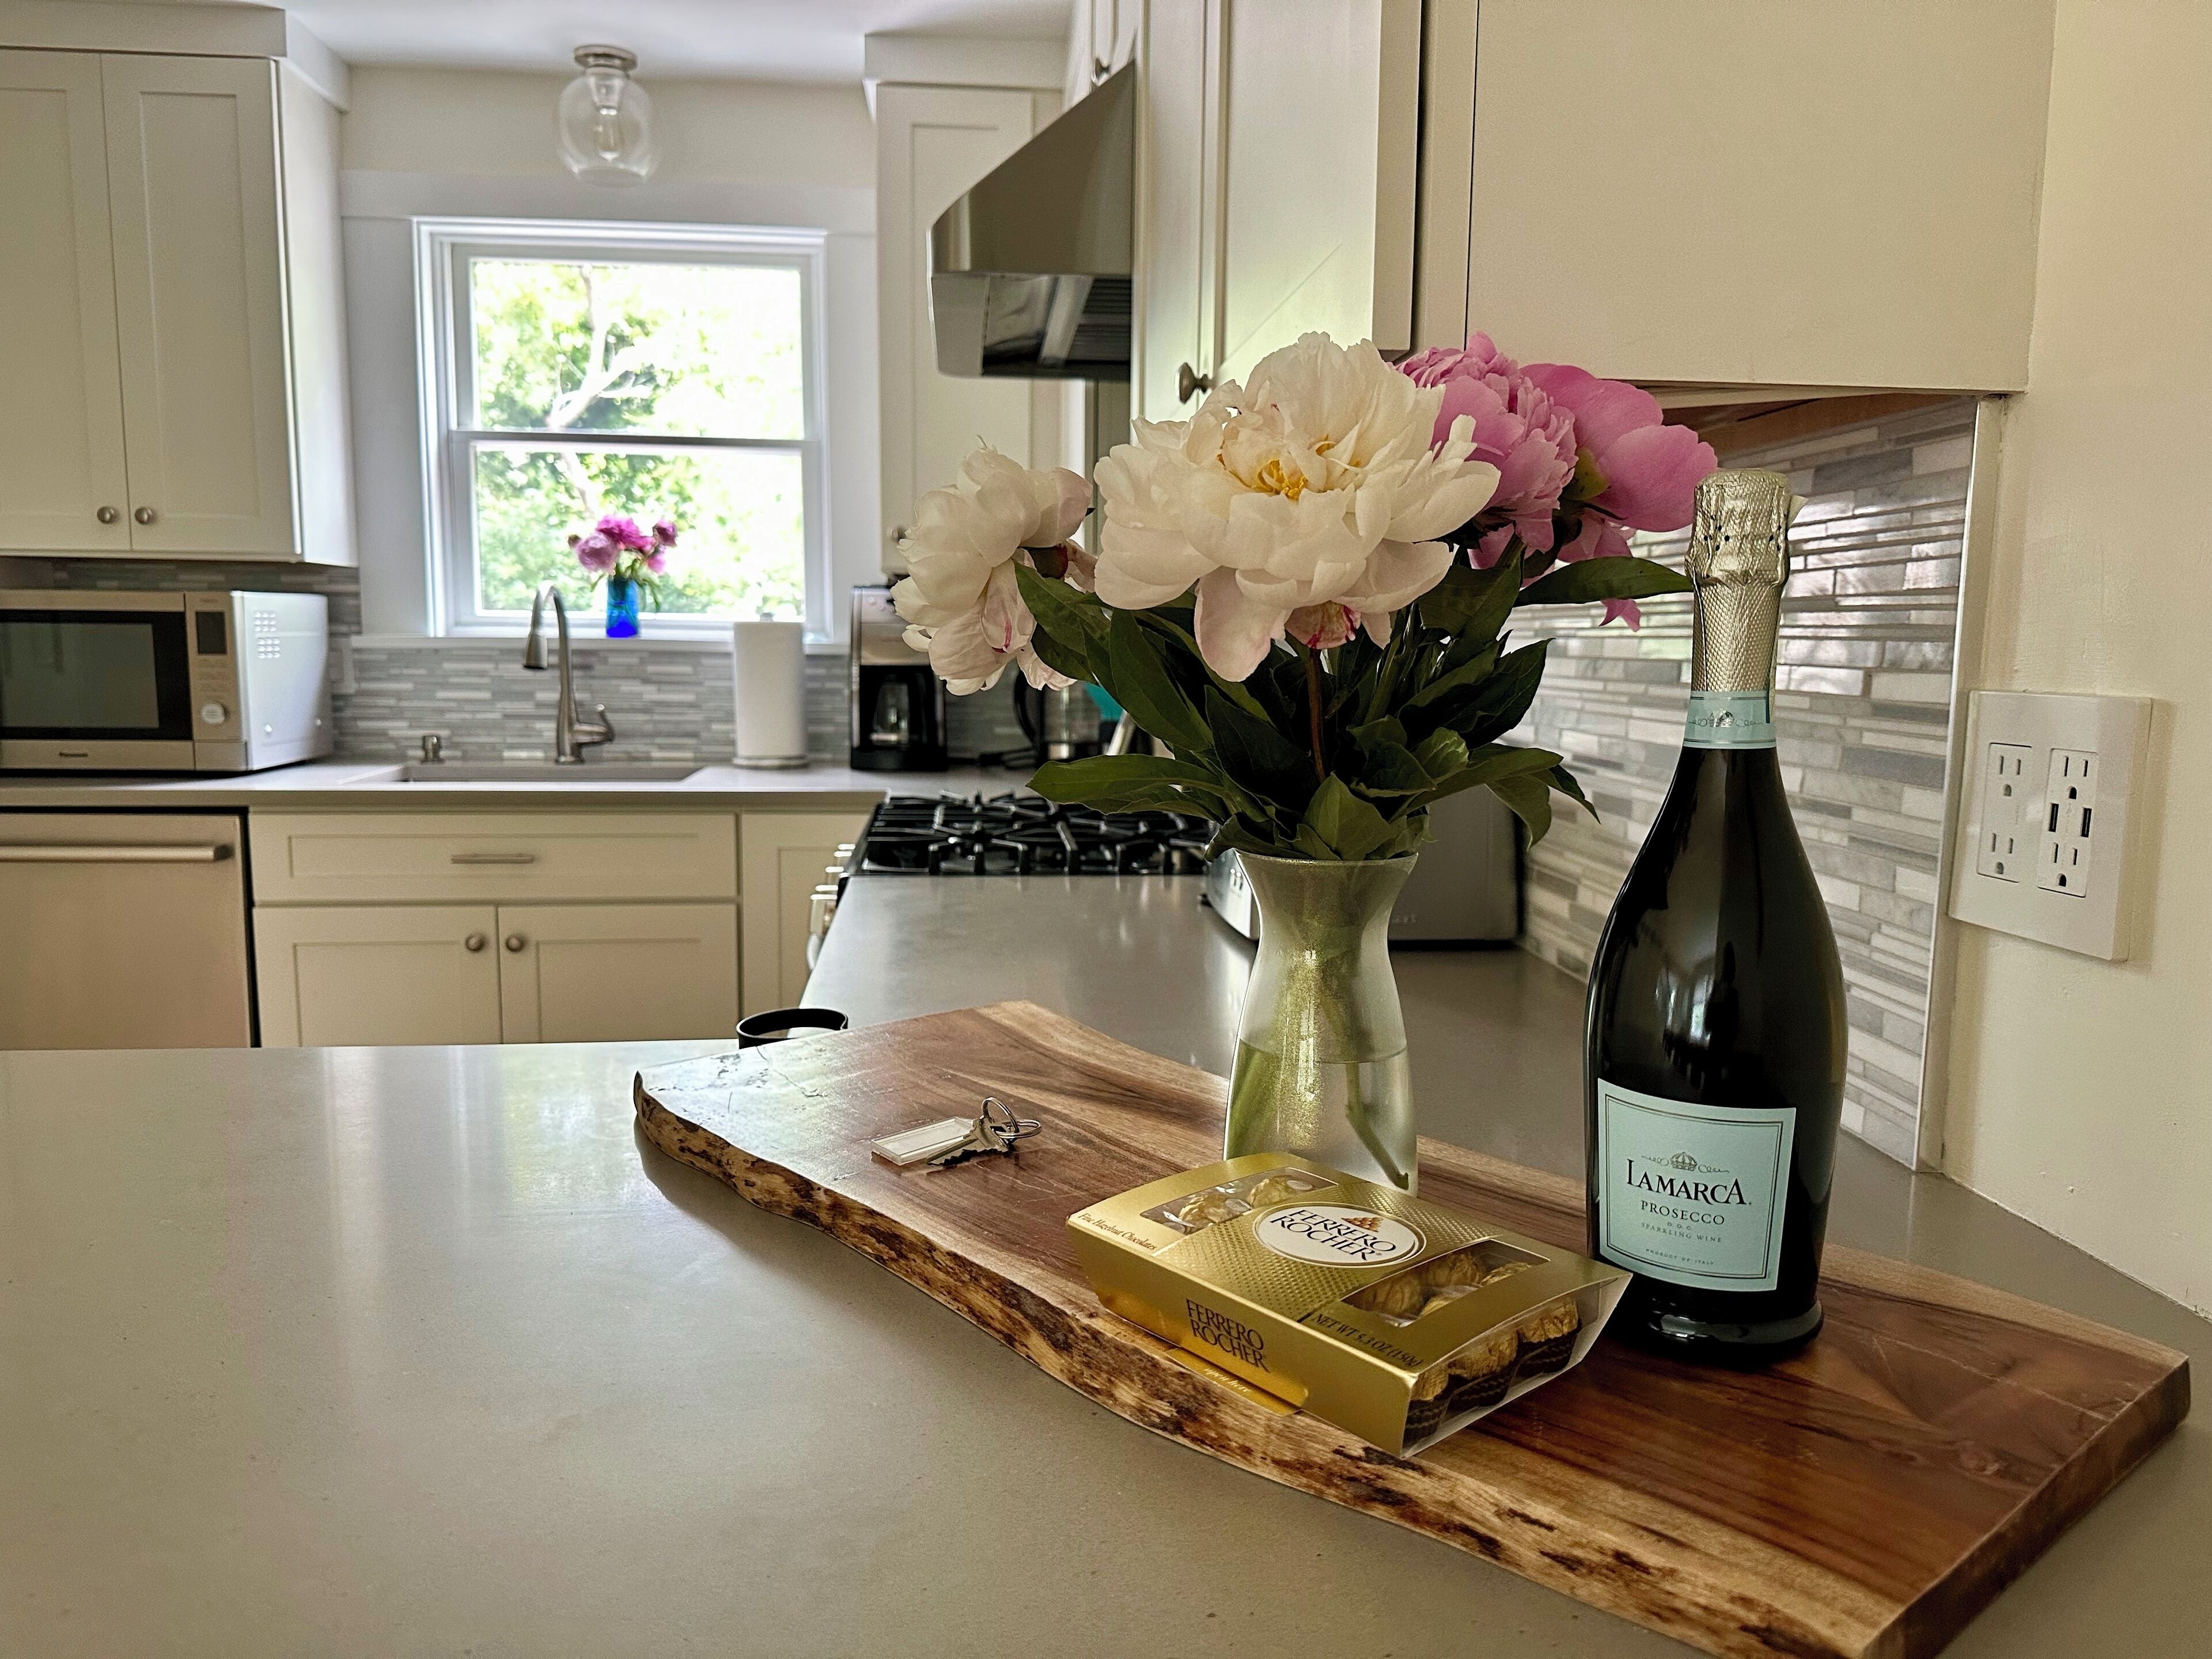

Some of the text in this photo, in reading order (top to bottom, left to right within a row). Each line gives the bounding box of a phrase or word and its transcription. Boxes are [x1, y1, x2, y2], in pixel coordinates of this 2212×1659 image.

[1289, 1210, 1396, 1252] FERRERO
[1641, 1200, 1725, 1225] PROSECCO
[1078, 1213, 1158, 1251] Fine Hazelnut Chocolates
[1641, 1222, 1722, 1243] SPARKLING WINE
[1646, 1248, 1677, 1260] PRODUCT
[1186, 1298, 1264, 1350] FERRERO
[1312, 1313, 1339, 1328] NET
[1336, 1323, 1359, 1336] WT
[1371, 1340, 1393, 1353] OZ
[1190, 1319, 1271, 1373] ROCHER
[1228, 1380, 1252, 1392] here
